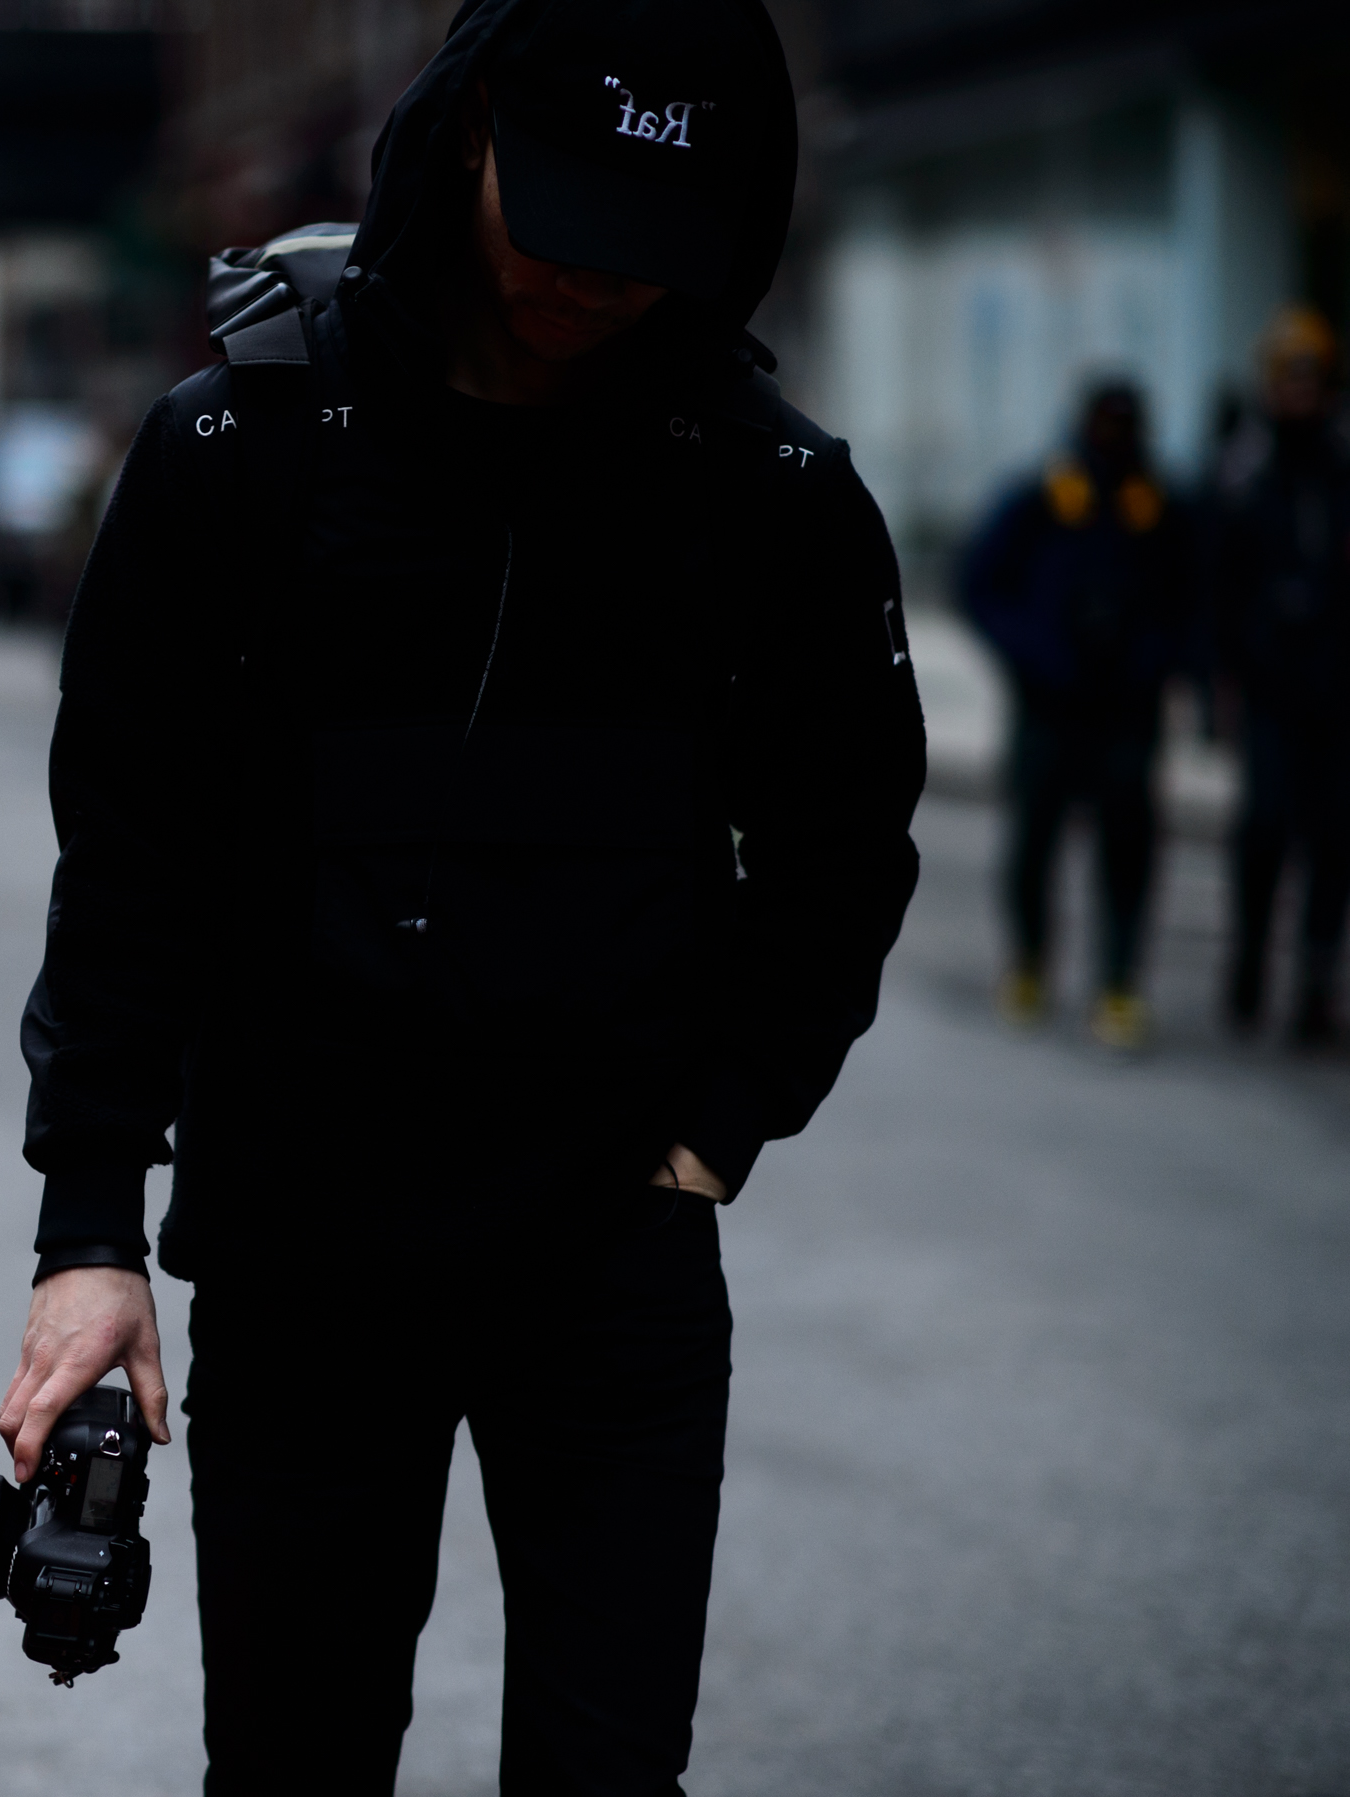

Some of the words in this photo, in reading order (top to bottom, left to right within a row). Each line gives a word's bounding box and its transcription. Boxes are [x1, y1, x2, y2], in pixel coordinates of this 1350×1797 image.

[195, 409, 239, 437] CA
[321, 406, 353, 429] PT
[669, 416, 702, 445] CA
[778, 444, 815, 469] PT
